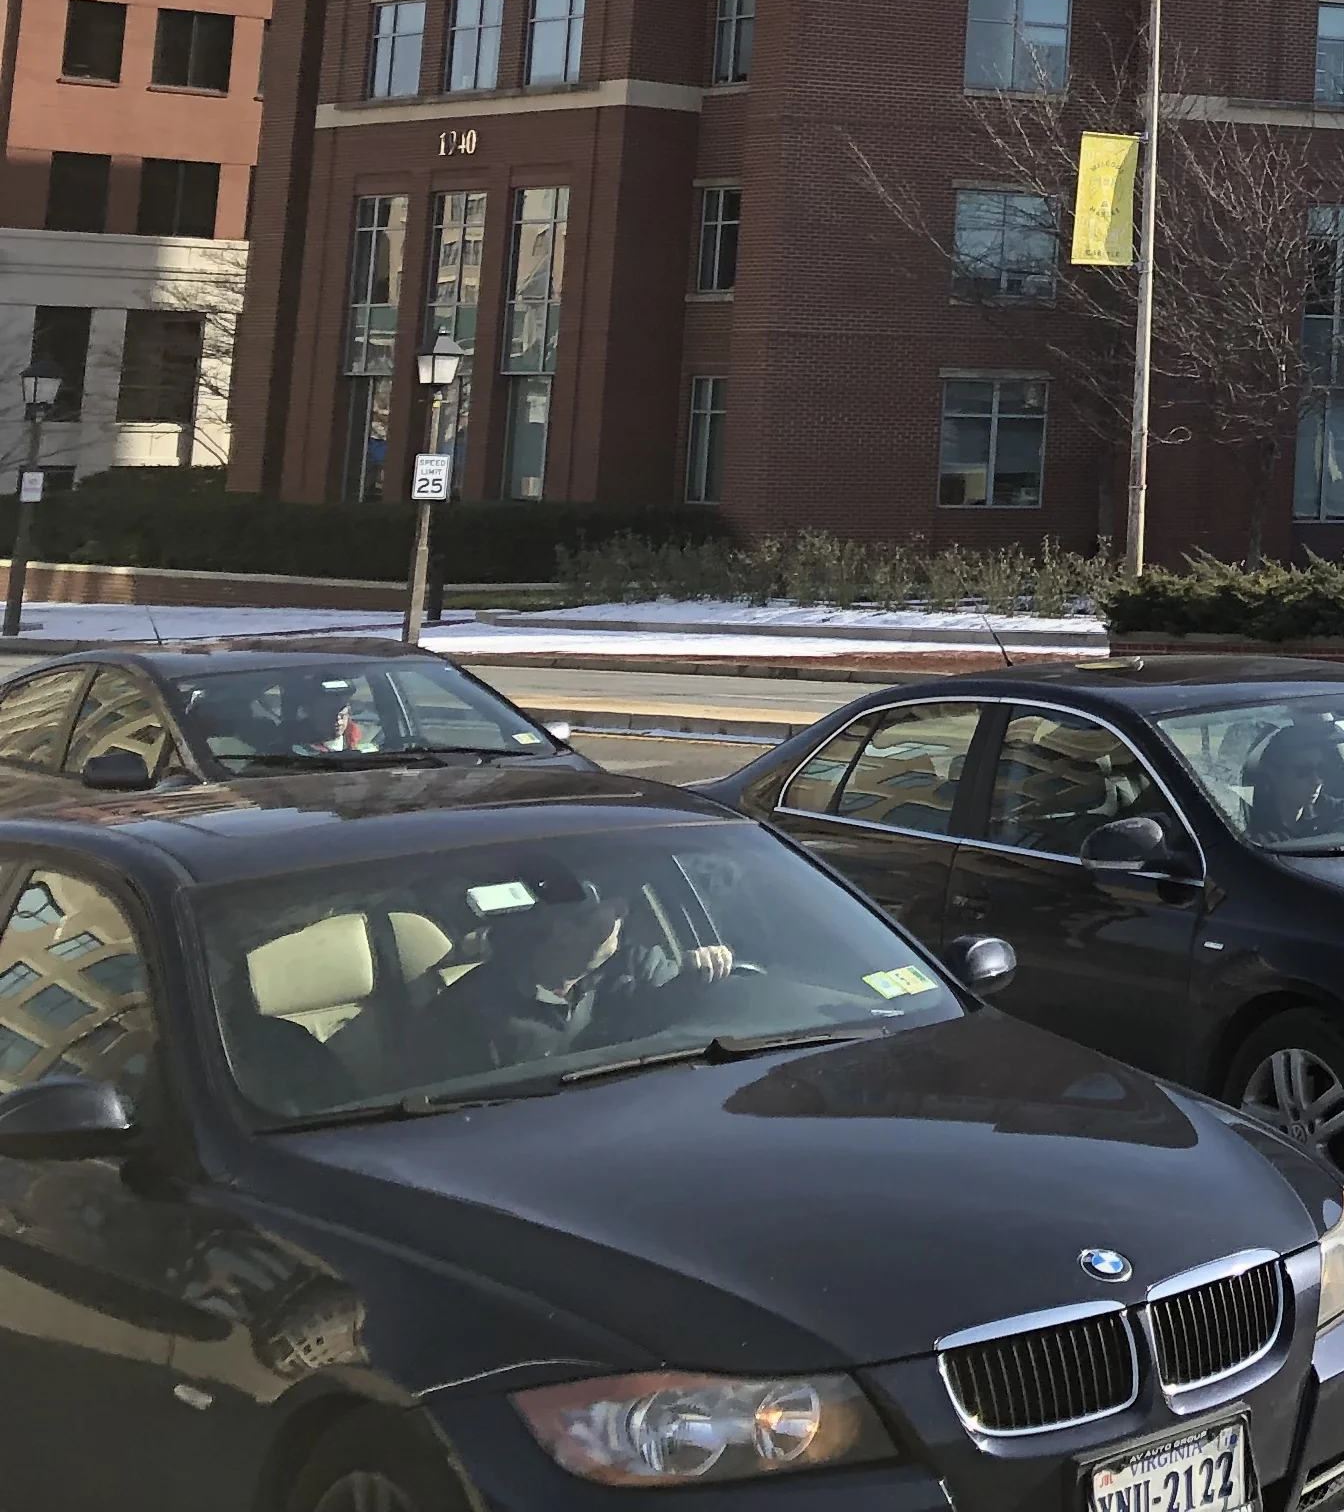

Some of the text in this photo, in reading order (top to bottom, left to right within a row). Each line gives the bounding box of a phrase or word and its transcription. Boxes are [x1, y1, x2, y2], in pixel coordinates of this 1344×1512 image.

[419, 458, 446, 467] SPEED
[420, 468, 443, 476] LIMIT
[417, 478, 443, 494] 25
[1145, 1443, 1172, 1458] AUTO
[1174, 1431, 1207, 1448] GROUP
[1130, 1439, 1203, 1477] VIRGINIA
